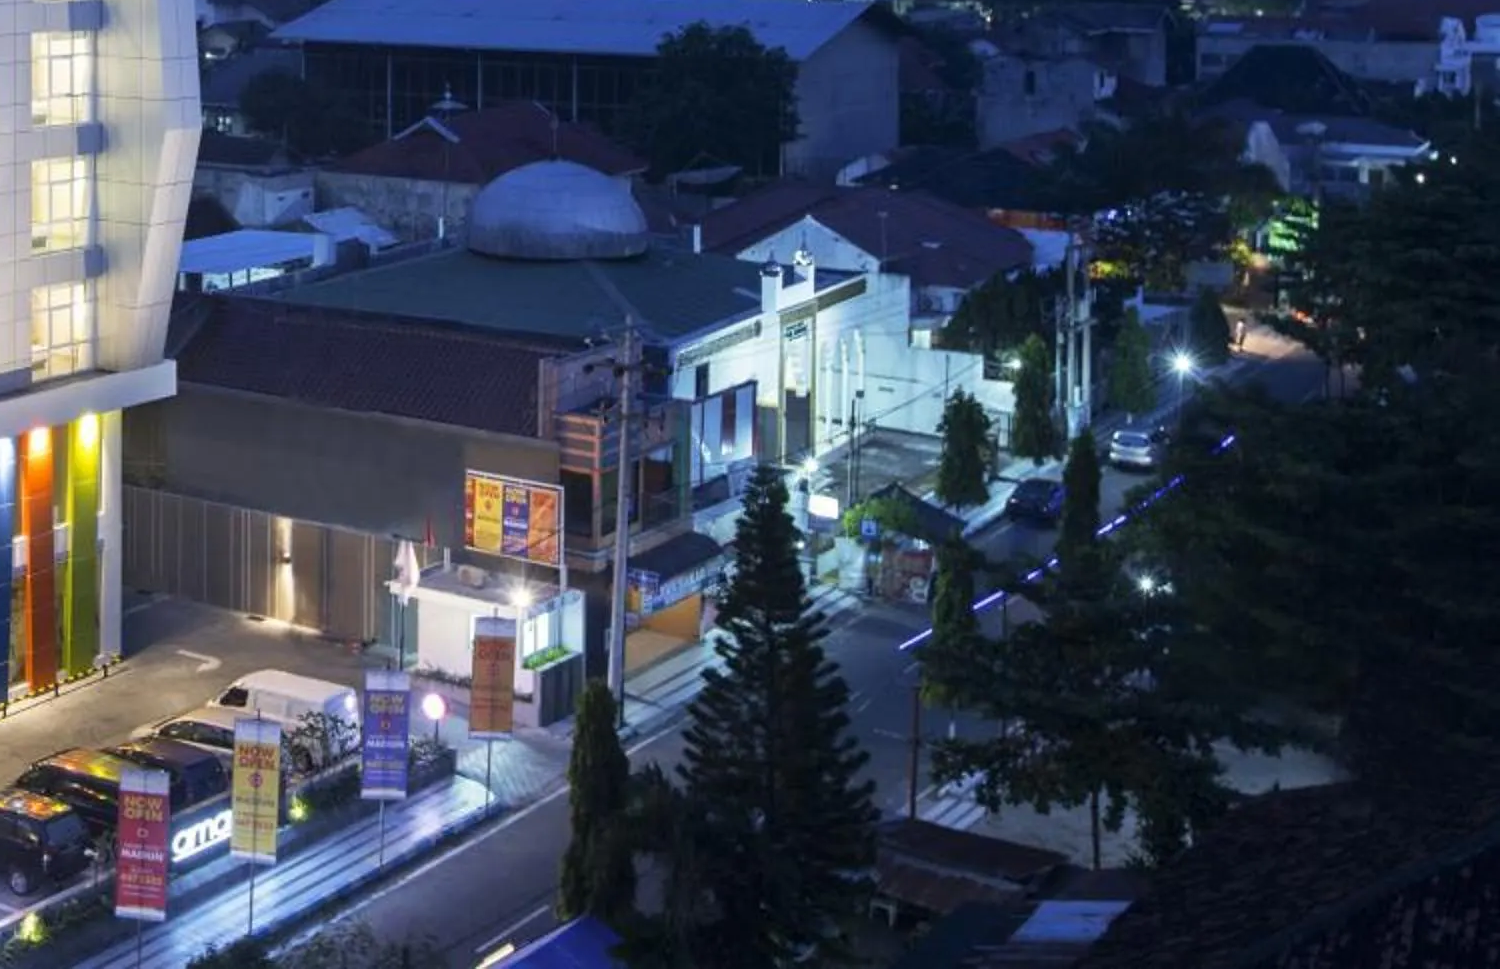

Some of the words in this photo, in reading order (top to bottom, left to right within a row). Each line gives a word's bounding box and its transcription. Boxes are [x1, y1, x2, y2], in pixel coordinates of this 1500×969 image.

[238, 744, 276, 758] NOW
[238, 756, 275, 770] OPEN
[123, 794, 163, 810] NOW
[123, 807, 163, 822] OPEN
[171, 809, 232, 857] ama
